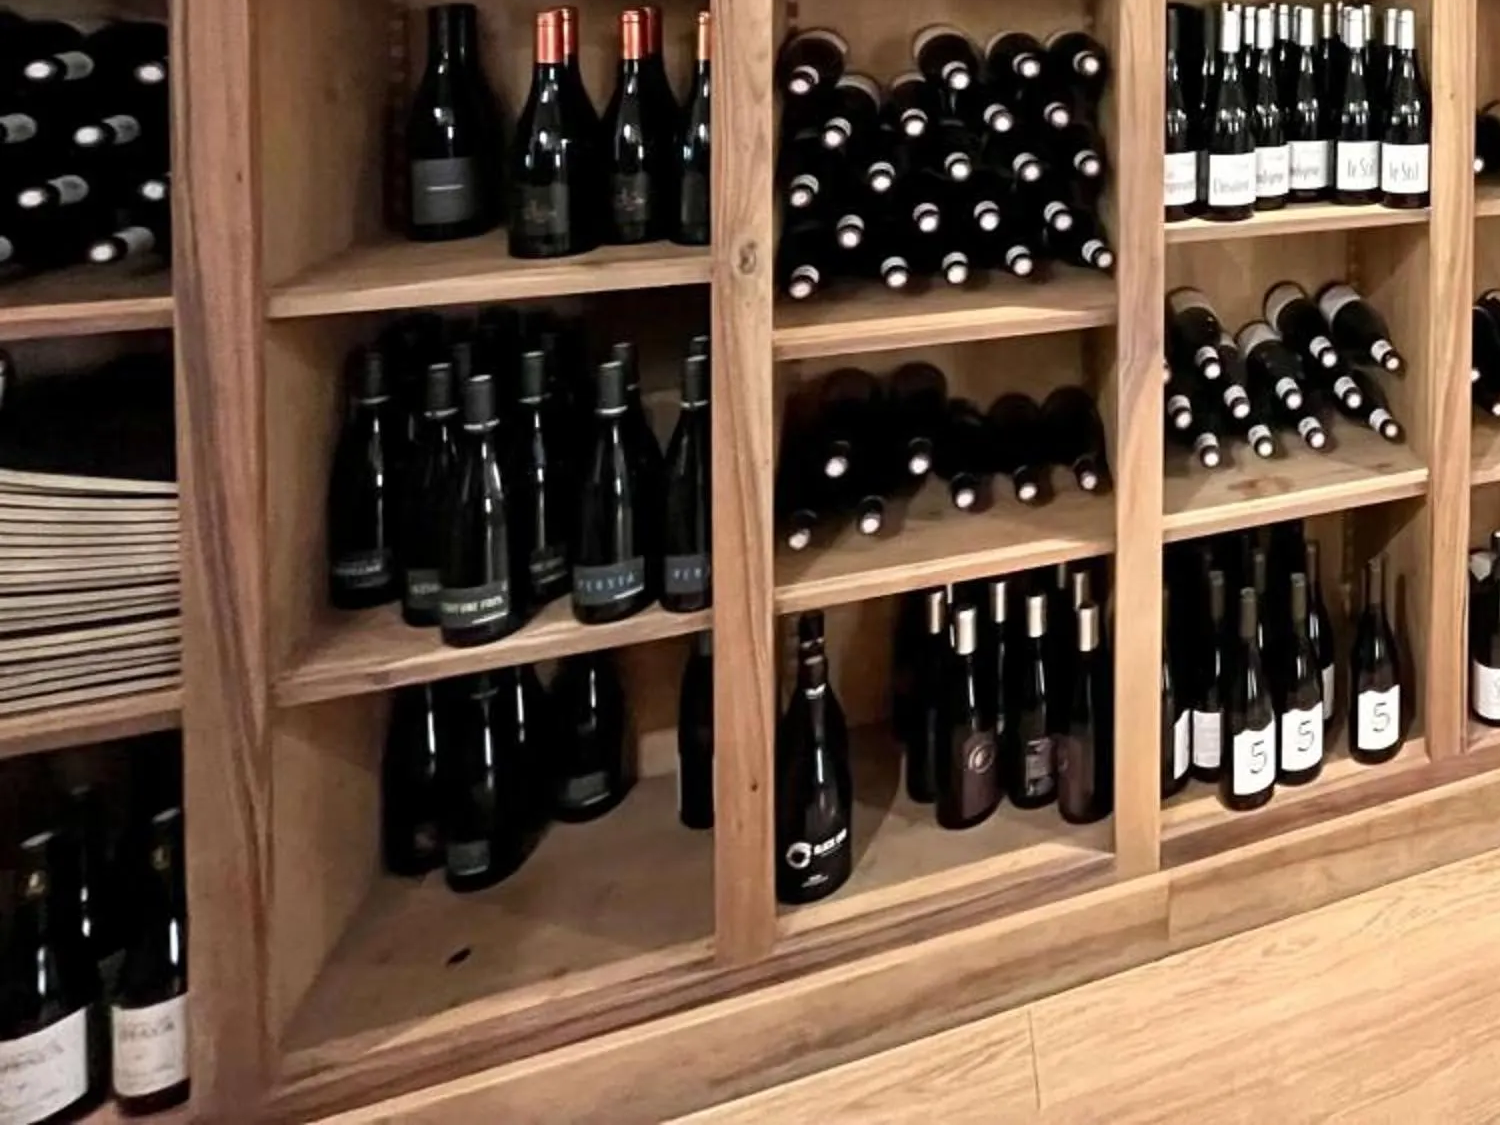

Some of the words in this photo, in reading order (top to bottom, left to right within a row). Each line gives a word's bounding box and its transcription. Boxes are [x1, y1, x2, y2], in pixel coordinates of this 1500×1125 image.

[1372, 702, 1391, 732] 5
[1297, 720, 1314, 752] 5
[1250, 740, 1267, 774] 5
